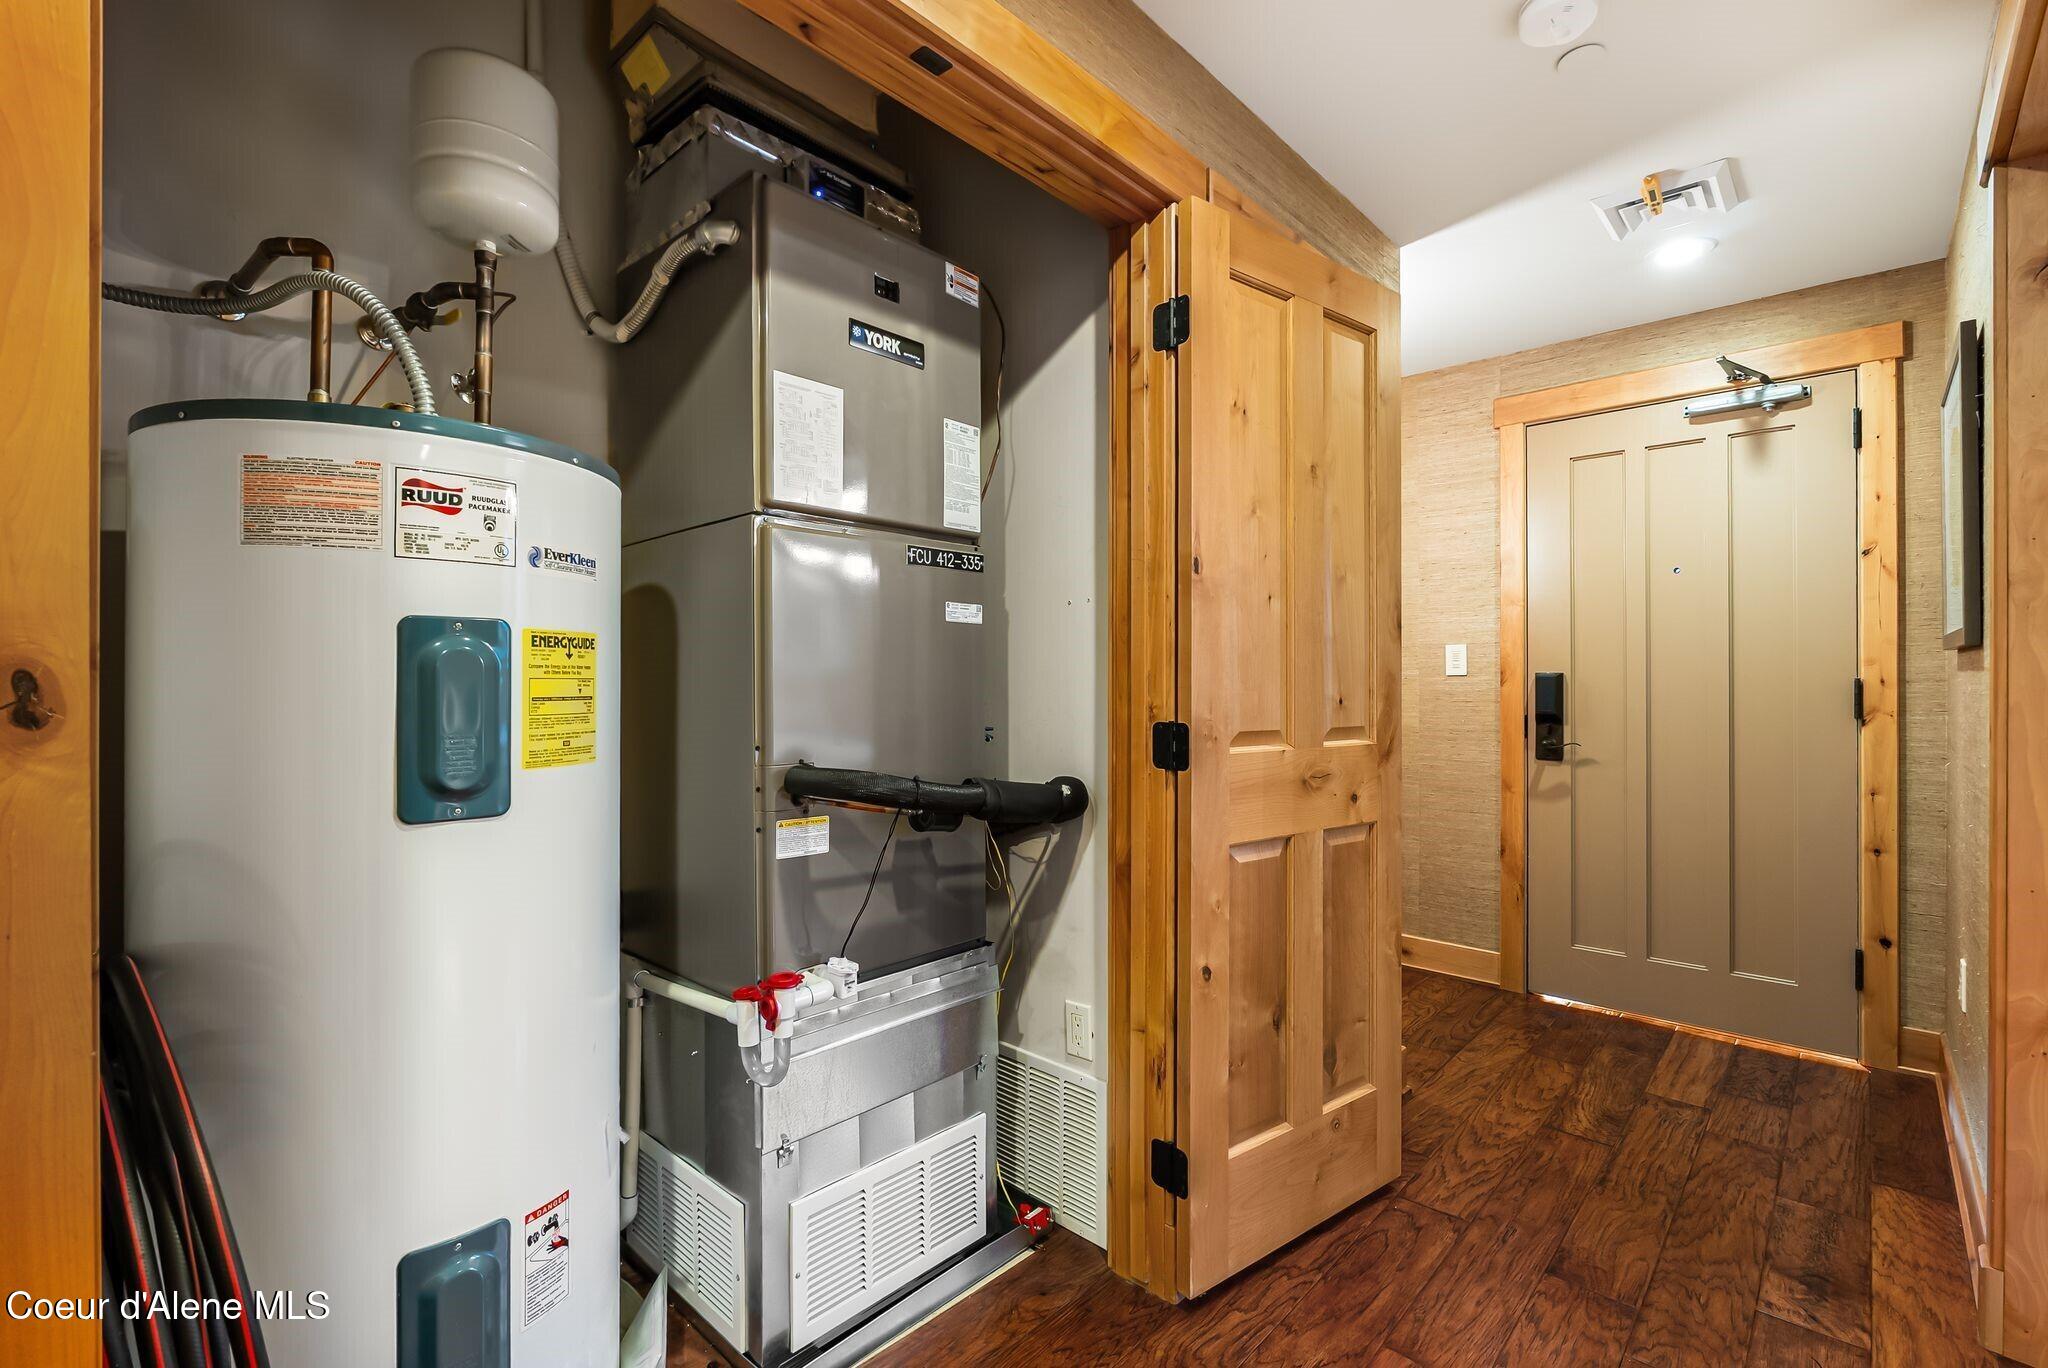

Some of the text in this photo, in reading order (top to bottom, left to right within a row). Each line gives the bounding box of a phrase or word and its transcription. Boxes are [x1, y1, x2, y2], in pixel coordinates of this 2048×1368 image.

[864, 328, 901, 355] YORK
[402, 488, 463, 506] RUUD
[544, 547, 596, 569] EverKleen
[909, 547, 981, 571] FCU 412-335
[531, 634, 595, 650] ENERGYGUIDE
[536, 1193, 568, 1217] DANGER
